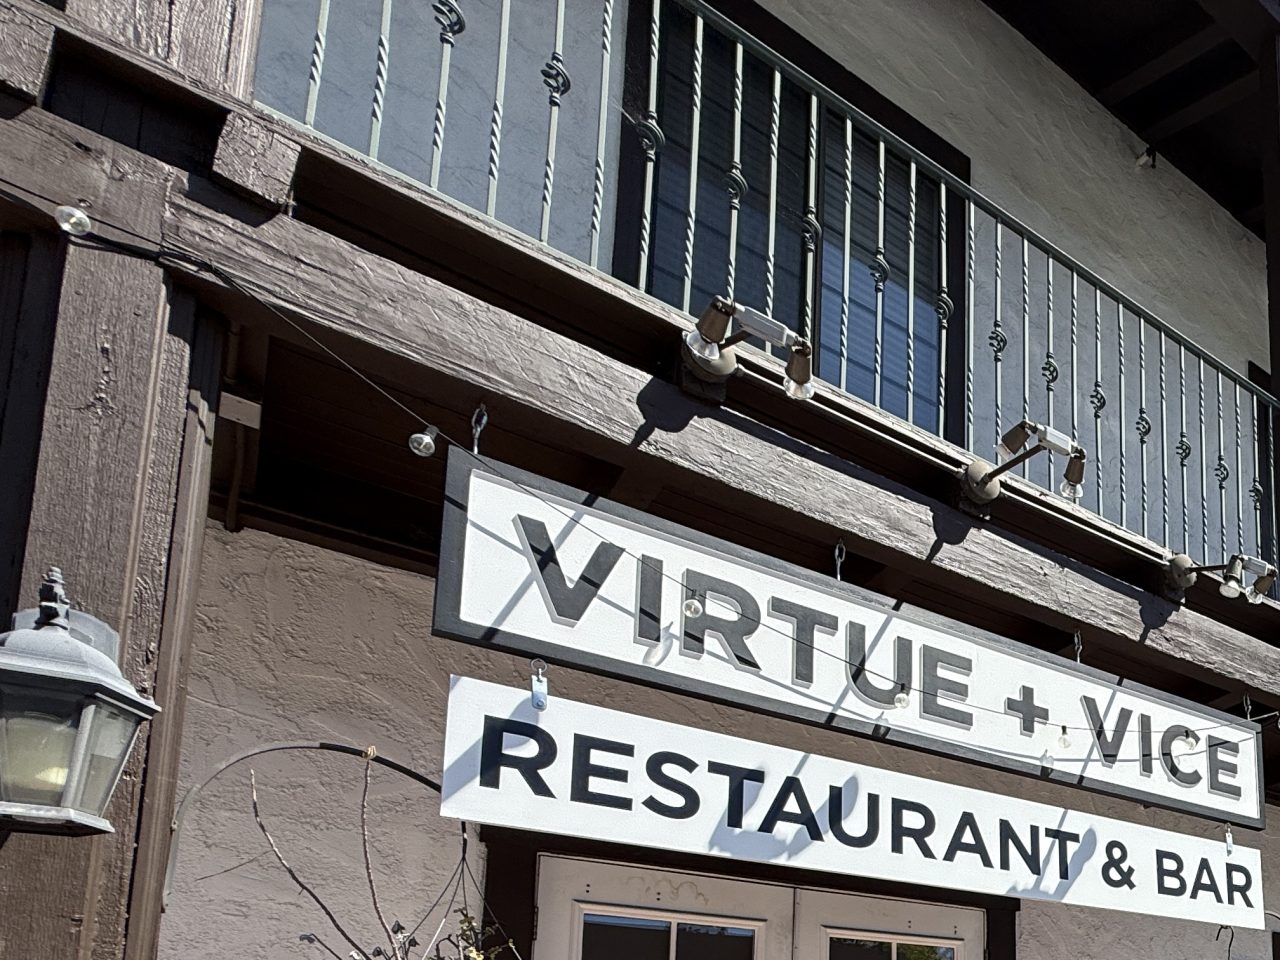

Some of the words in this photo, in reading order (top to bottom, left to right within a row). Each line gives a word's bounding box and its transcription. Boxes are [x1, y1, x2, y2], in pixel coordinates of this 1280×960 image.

[512, 514, 973, 729] VIRTUE
[1003, 684, 1049, 736] +
[1080, 694, 1242, 798] VICE
[479, 714, 1080, 881] RESTAURANT
[1101, 840, 1137, 890] &
[1157, 850, 1255, 909] BAR
